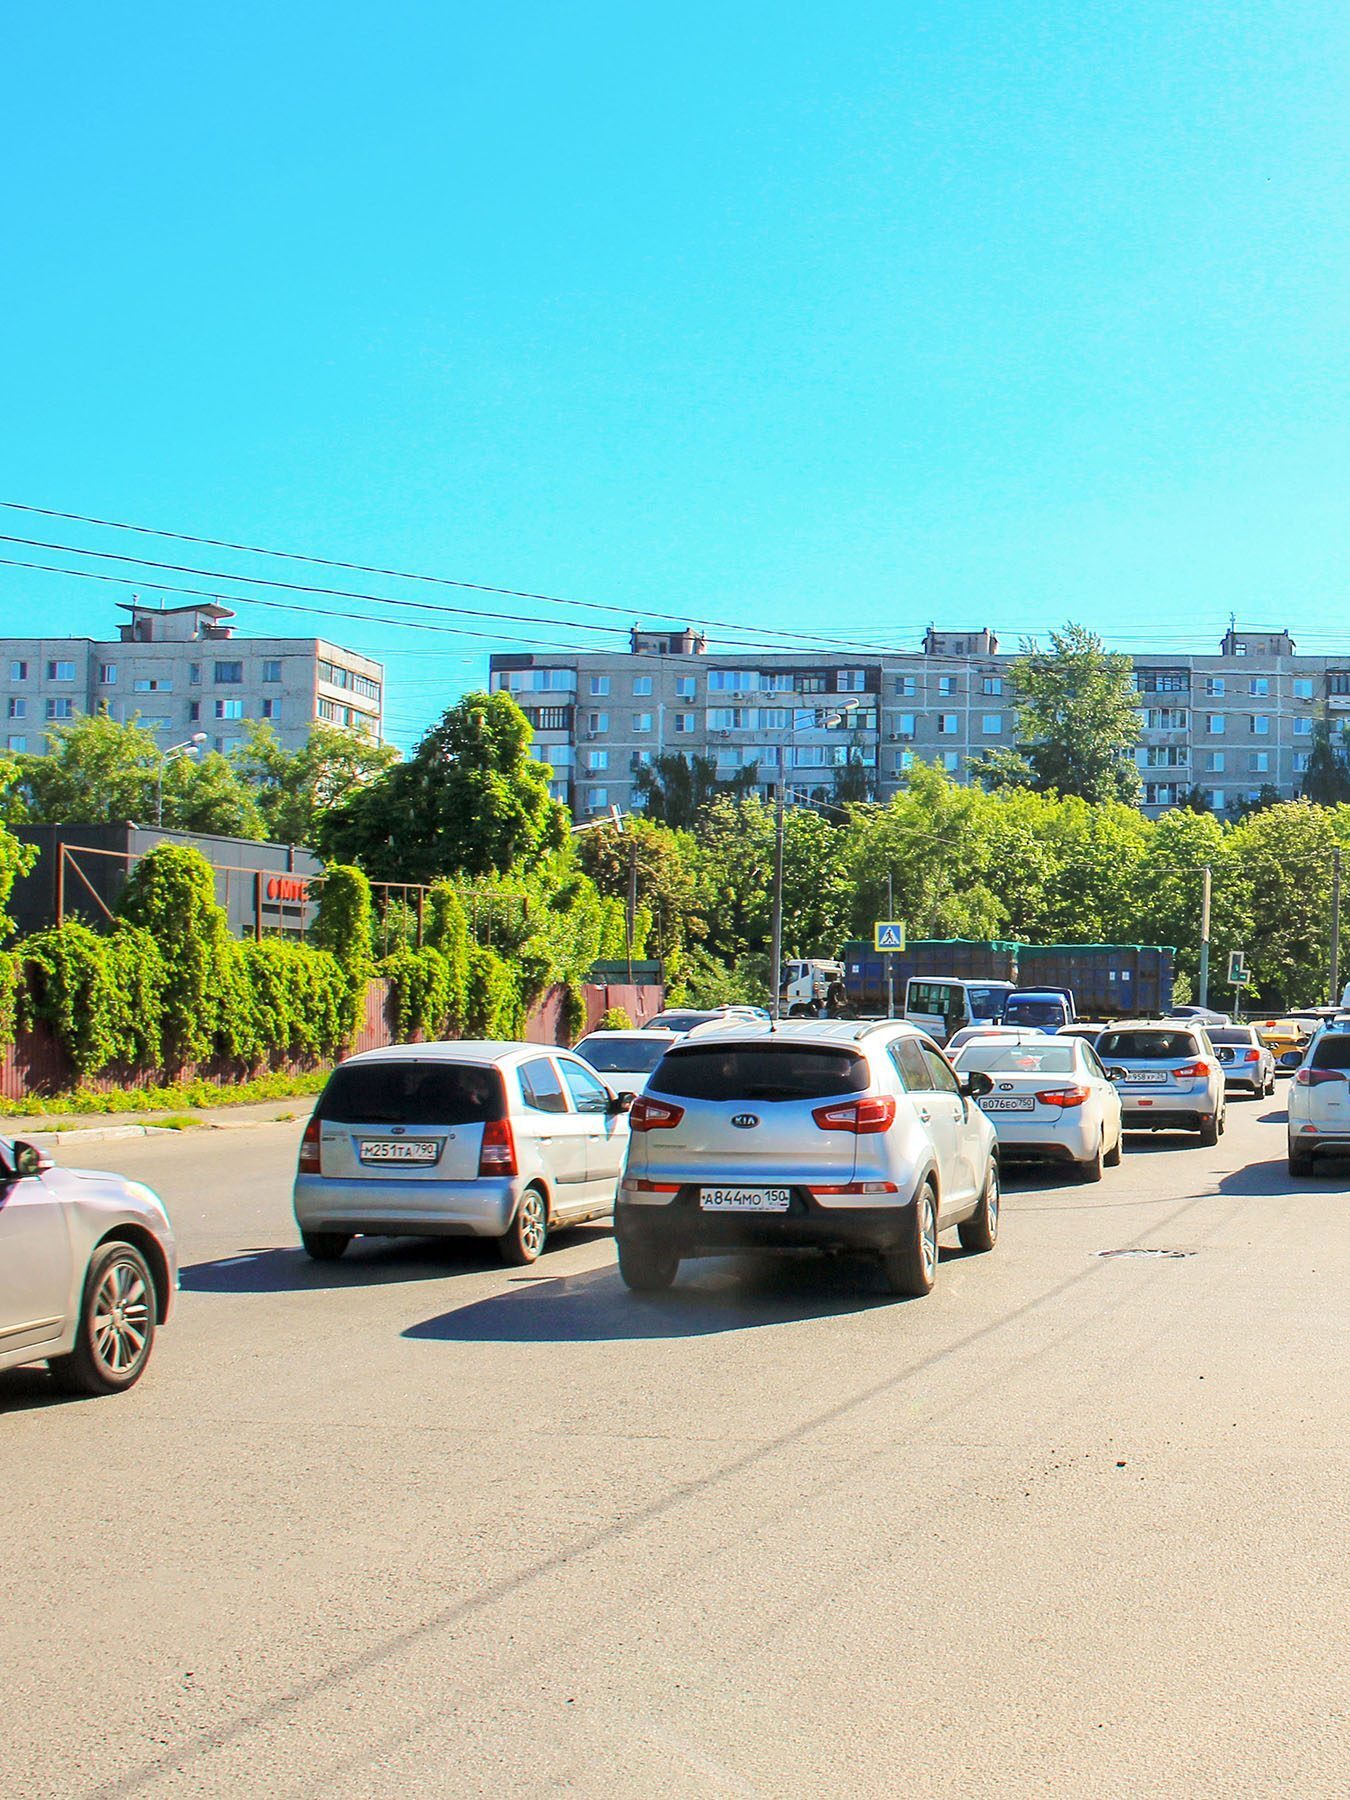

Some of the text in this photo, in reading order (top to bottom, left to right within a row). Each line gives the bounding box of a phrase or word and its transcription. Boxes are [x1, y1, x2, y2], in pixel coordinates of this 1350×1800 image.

[982, 1099, 1018, 1109] В076ЕО
[734, 1116, 756, 1125] KIA
[364, 1143, 434, 1158] М251ТА 790
[704, 1190, 786, 1205] А844МО 150
